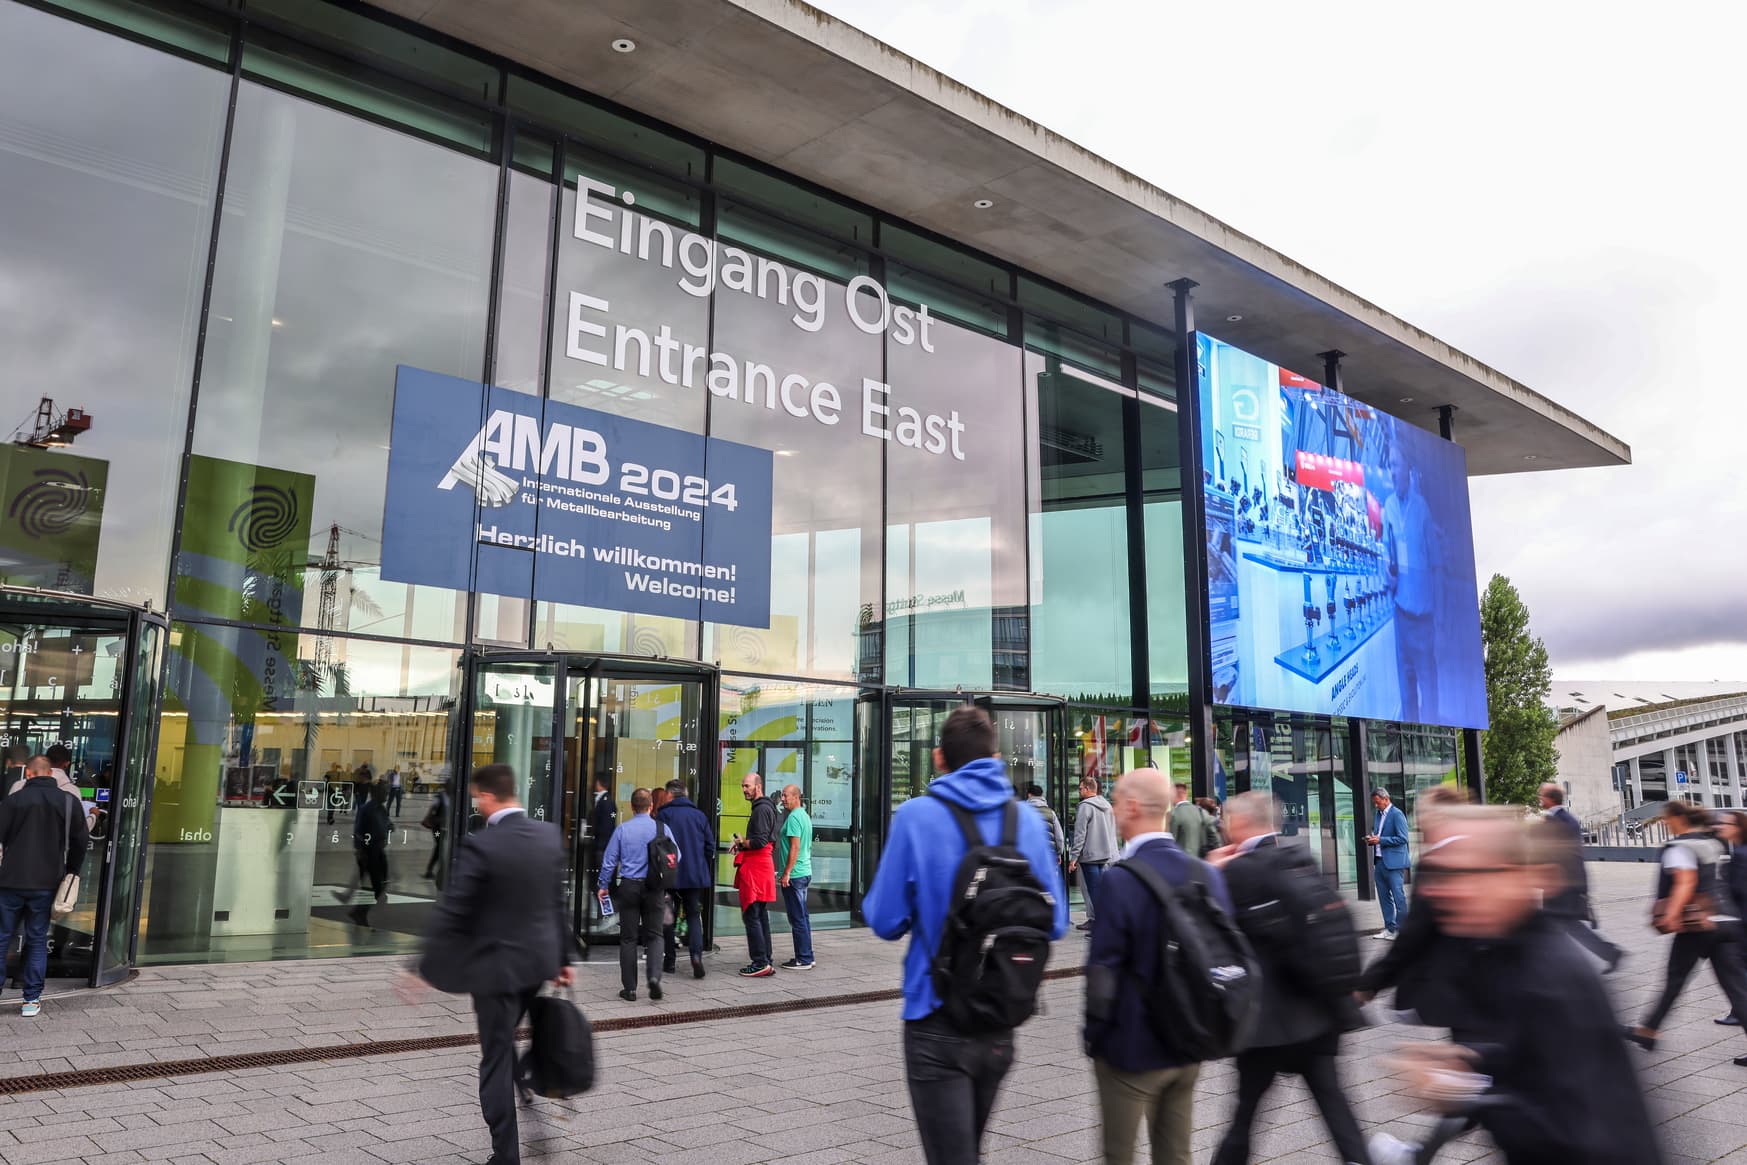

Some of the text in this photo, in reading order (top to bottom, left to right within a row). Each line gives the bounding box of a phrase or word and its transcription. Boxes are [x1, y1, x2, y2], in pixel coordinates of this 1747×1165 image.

[573, 174, 935, 353] Eingang Ost
[566, 291, 965, 461] Entrance East
[437, 409, 738, 512] AMB 2024
[521, 493, 671, 532] für Metallbearbeitung
[522, 477, 701, 522] Internationale Ausstellung
[476, 524, 736, 582] Herzlich willkommen!
[625, 572, 736, 604] Welcome!
[726, 728, 737, 764] Mese
